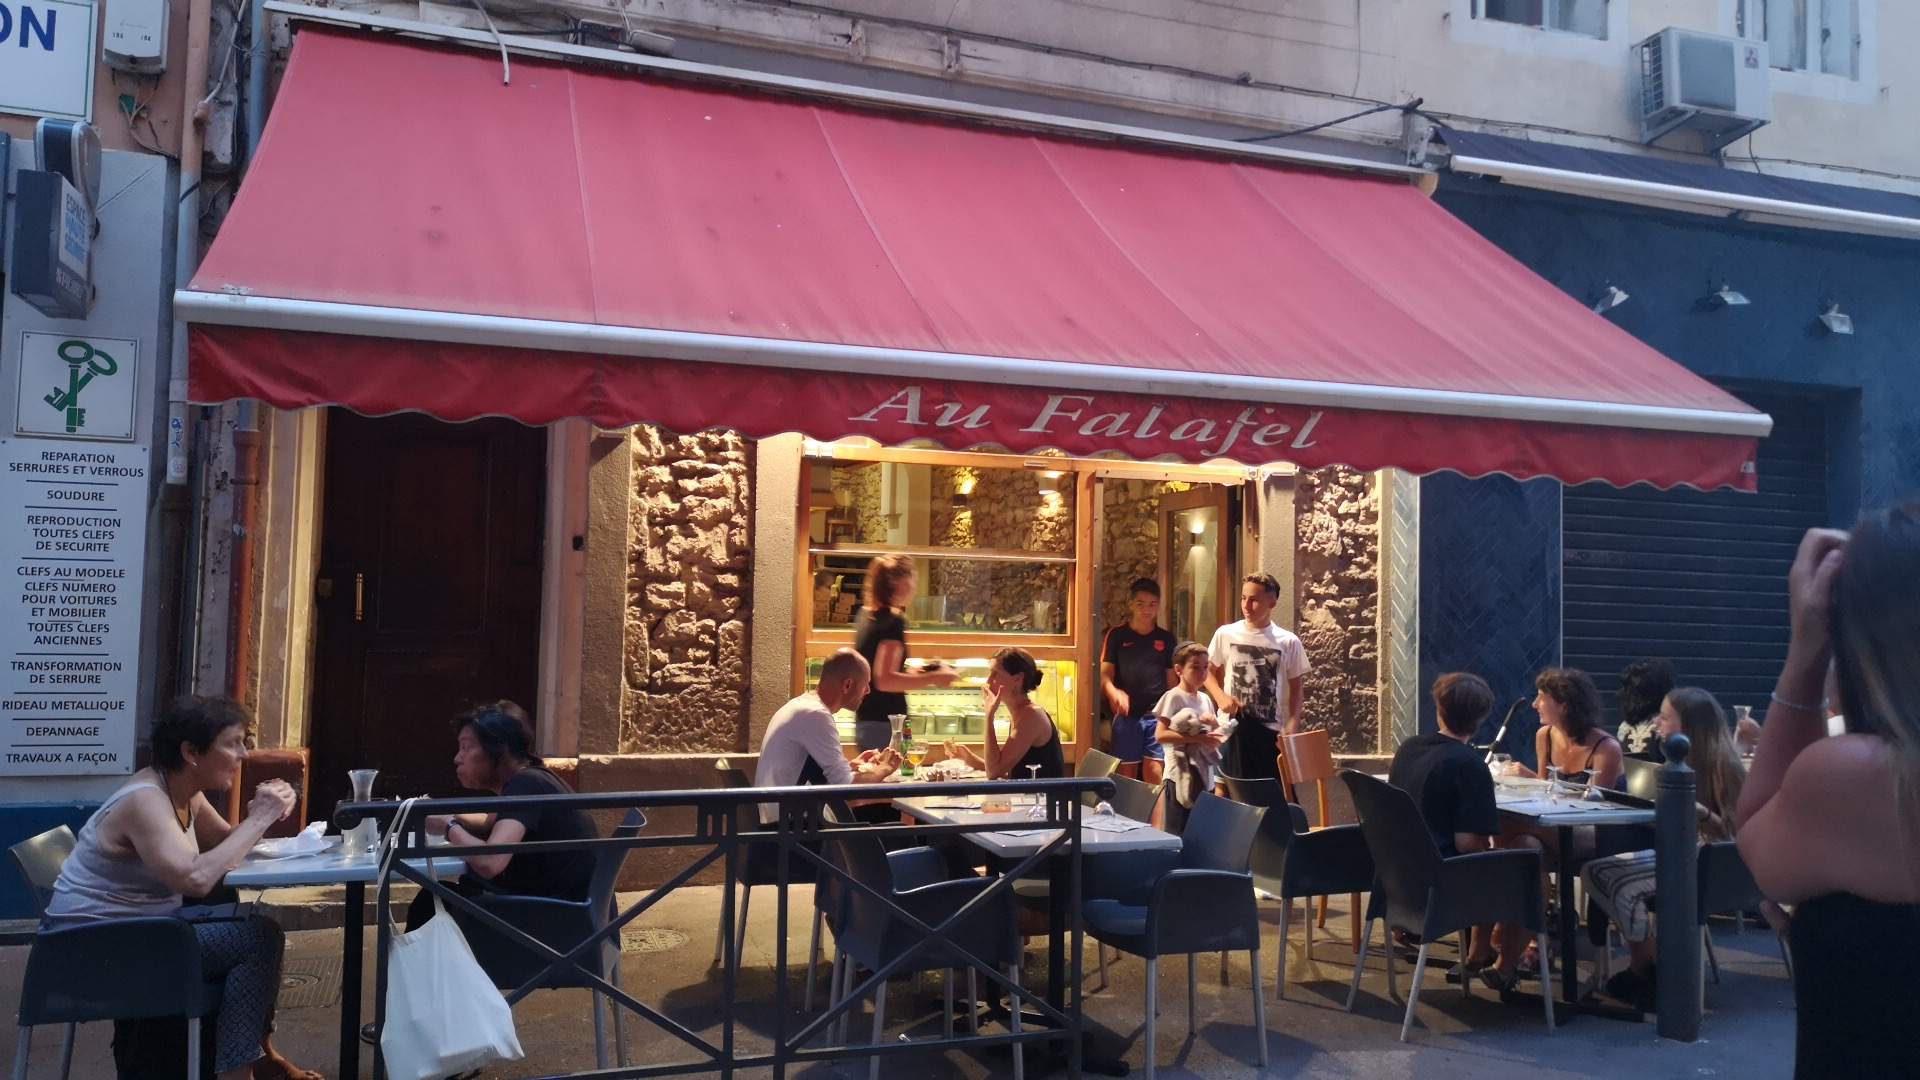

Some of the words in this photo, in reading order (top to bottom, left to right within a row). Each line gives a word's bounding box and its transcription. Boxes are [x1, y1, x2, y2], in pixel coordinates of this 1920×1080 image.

[848, 385, 992, 427] Au
[1018, 394, 1324, 457] Falafel
[42, 452, 114, 463] REPARATION
[10, 463, 69, 473] SERRURES
[73, 466, 86, 474] ET
[90, 466, 143, 477] VERROUS
[48, 490, 104, 501] SOUDURE
[28, 515, 120, 527] REPRODUCTION
[33, 528, 78, 538] TOUTES
[83, 530, 114, 539] CLEFS
[36, 541, 51, 550] DE
[56, 542, 109, 552] SECURITE
[17, 567, 50, 576] CLEFS
[54, 568, 71, 576] AU
[76, 568, 125, 578] MODELE
[25, 582, 58, 591] CLEFS
[62, 583, 115, 593] NUMERO
[22, 595, 55, 604] POUR
[60, 595, 117, 605] VOITURES
[32, 608, 45, 616] ET
[49, 608, 105, 617] MOBILIER
[28, 623, 73, 632] TOUTES
[77, 624, 109, 632] CLEFS
[34, 636, 102, 645] ANCIENNES
[11, 661, 121, 671] TRANSFORMATION
[30, 674, 44, 683] DE
[49, 675, 100, 683] SERRURE
[3, 701, 47, 710] RIDEAU
[52, 701, 124, 711] METALLIQUE
[27, 727, 99, 736] DEPANNAGE
[7, 753, 61, 763] TRAVAUX
[65, 753, 73, 762] A
[78, 753, 116, 765] FAÇON
